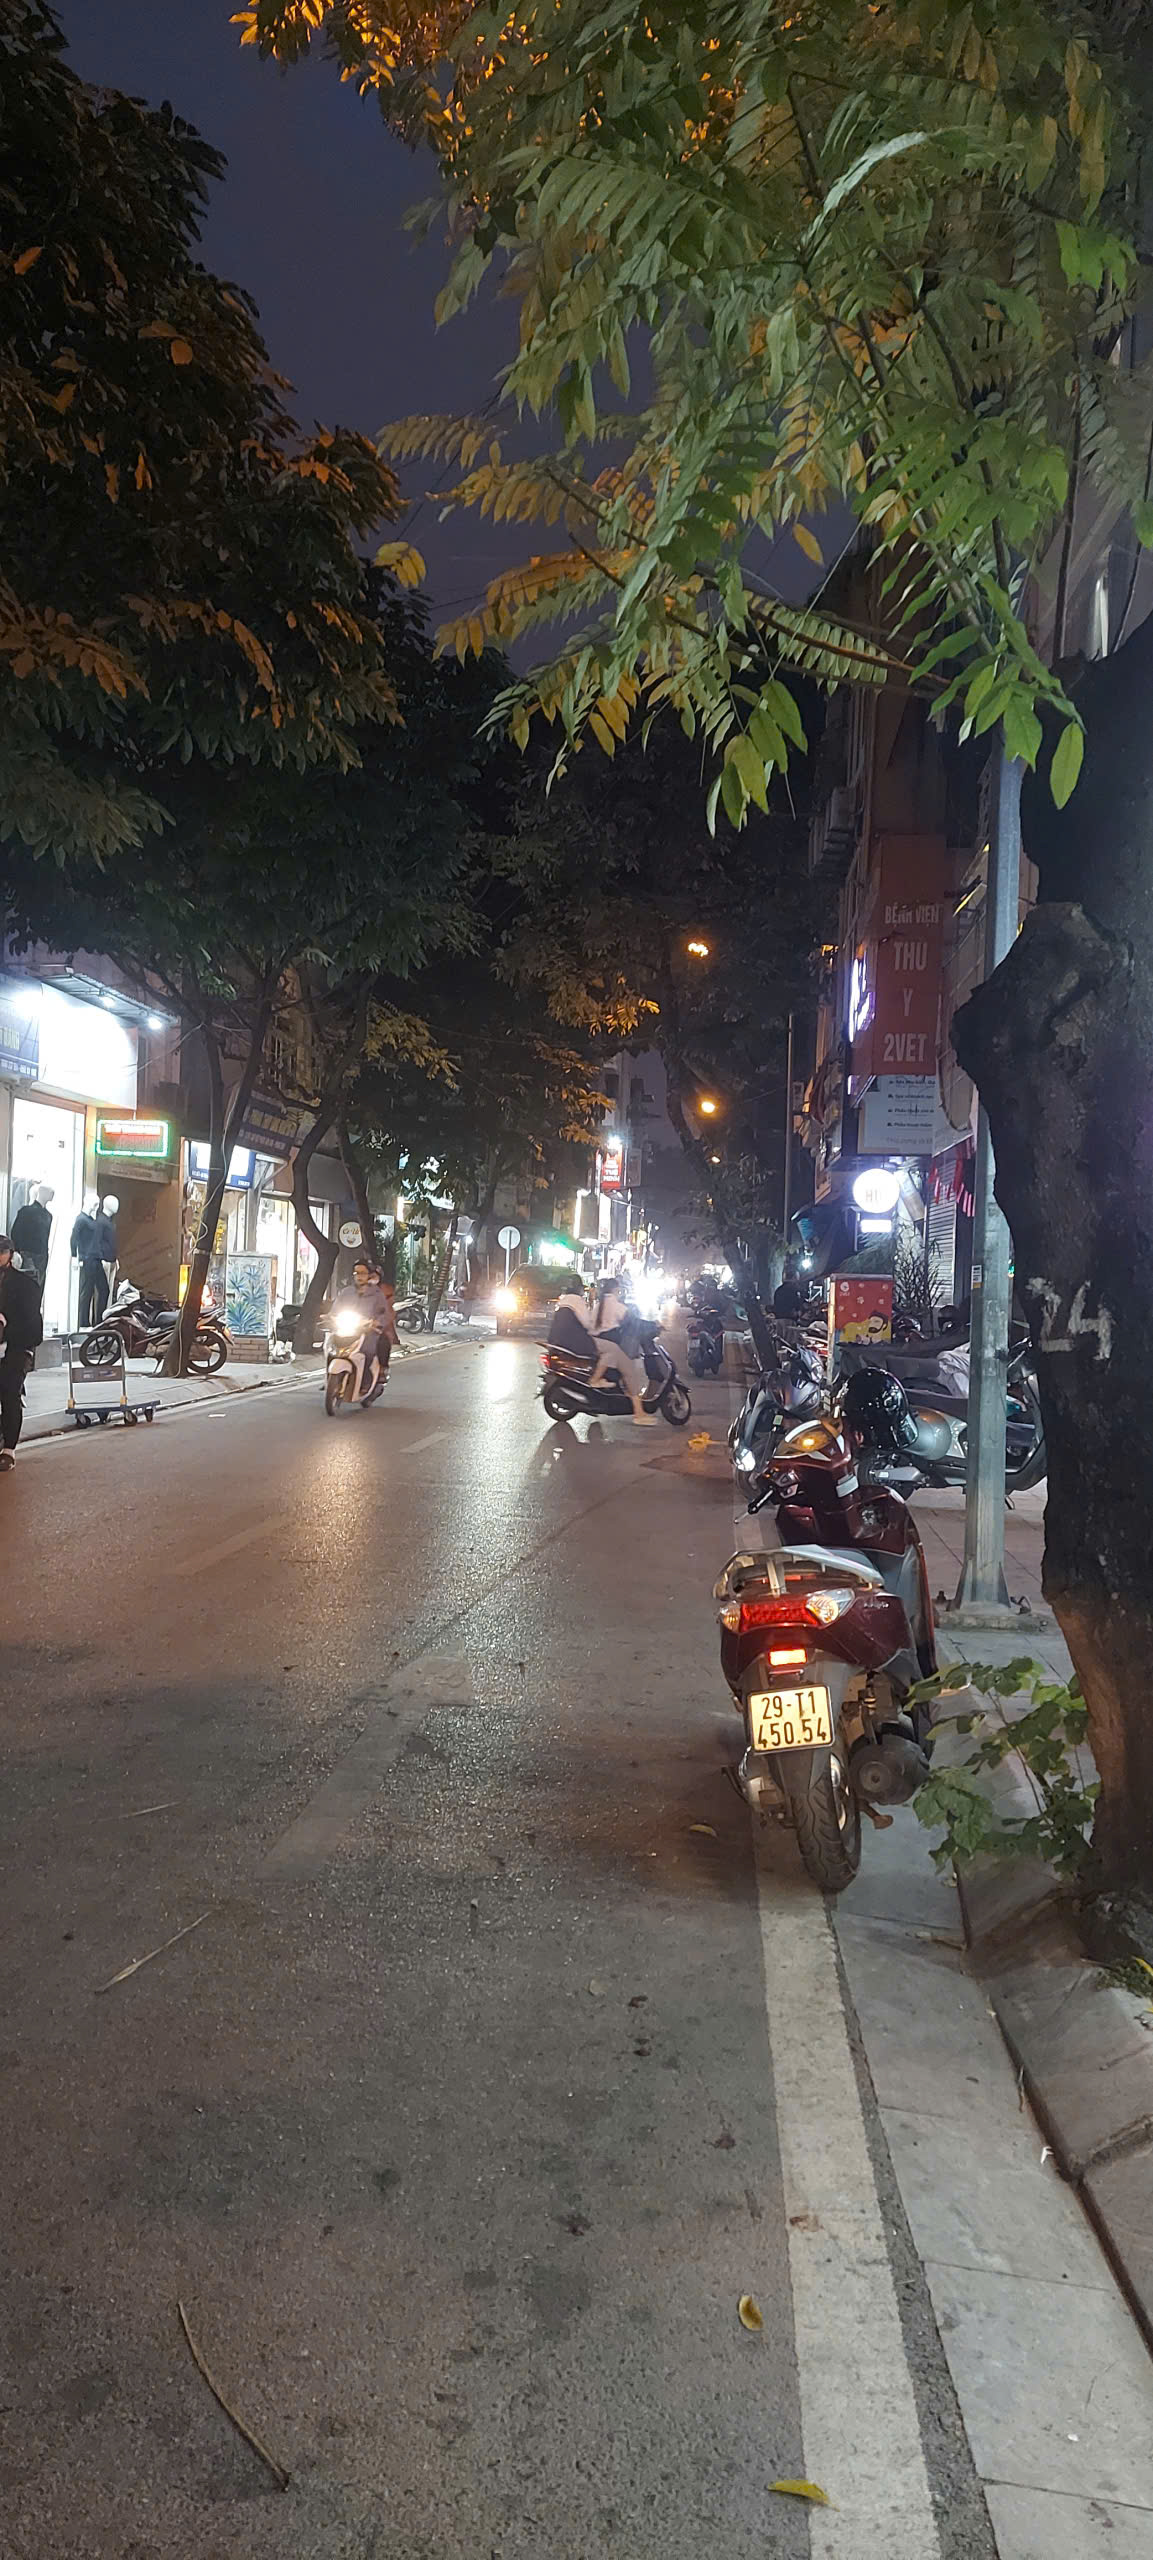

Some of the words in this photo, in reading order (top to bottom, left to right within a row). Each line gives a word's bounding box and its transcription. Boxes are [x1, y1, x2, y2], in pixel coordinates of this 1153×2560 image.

[883, 1033, 927, 1062] 2VET
[761, 1691, 816, 1720] 29-T1
[757, 1717, 827, 1748] 450.54
